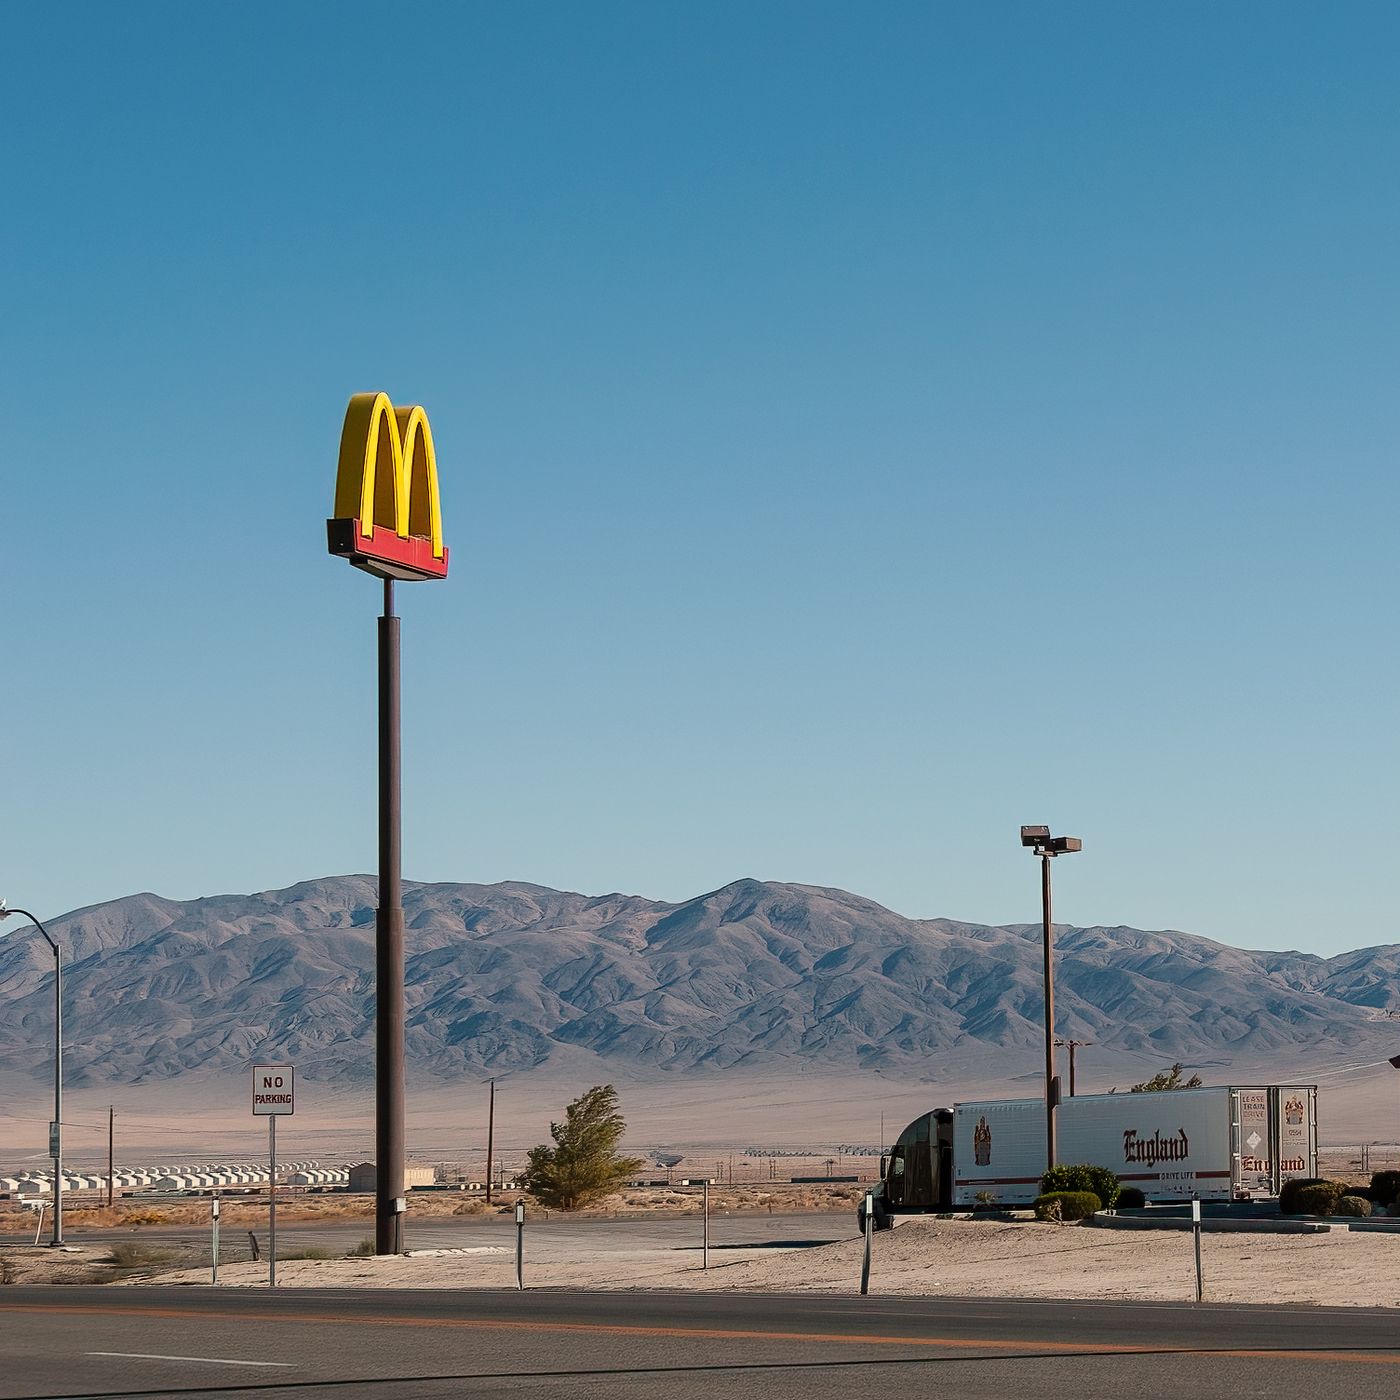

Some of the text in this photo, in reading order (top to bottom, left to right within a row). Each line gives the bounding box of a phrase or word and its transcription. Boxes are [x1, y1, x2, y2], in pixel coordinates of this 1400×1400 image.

[263, 1076, 283, 1088] NO
[255, 1094, 292, 1104] PARKING
[1123, 1128, 1189, 1168] England
